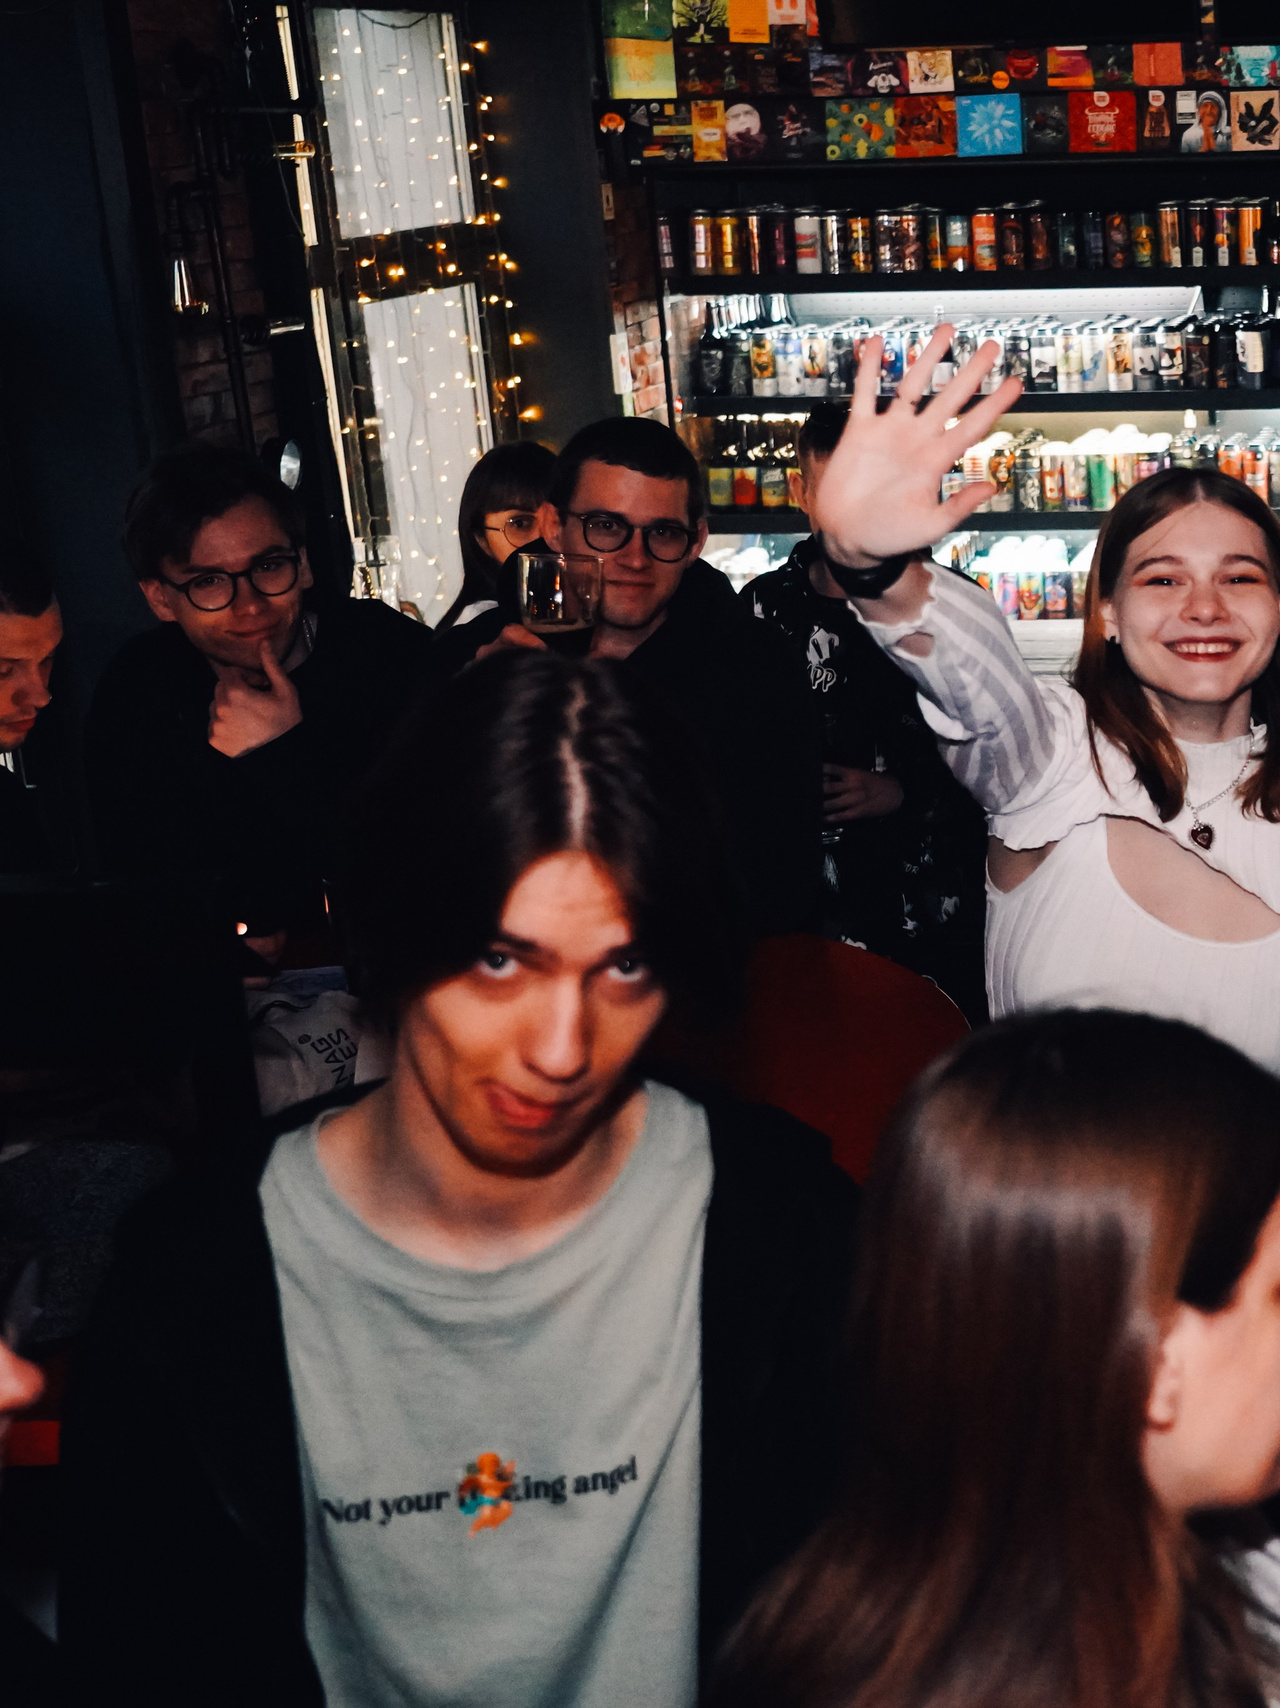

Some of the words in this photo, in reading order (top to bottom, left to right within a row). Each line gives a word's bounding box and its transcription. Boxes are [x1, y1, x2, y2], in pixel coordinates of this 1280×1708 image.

[321, 1496, 372, 1524] Not
[378, 1490, 452, 1527] your
[573, 1455, 638, 1496] angel
